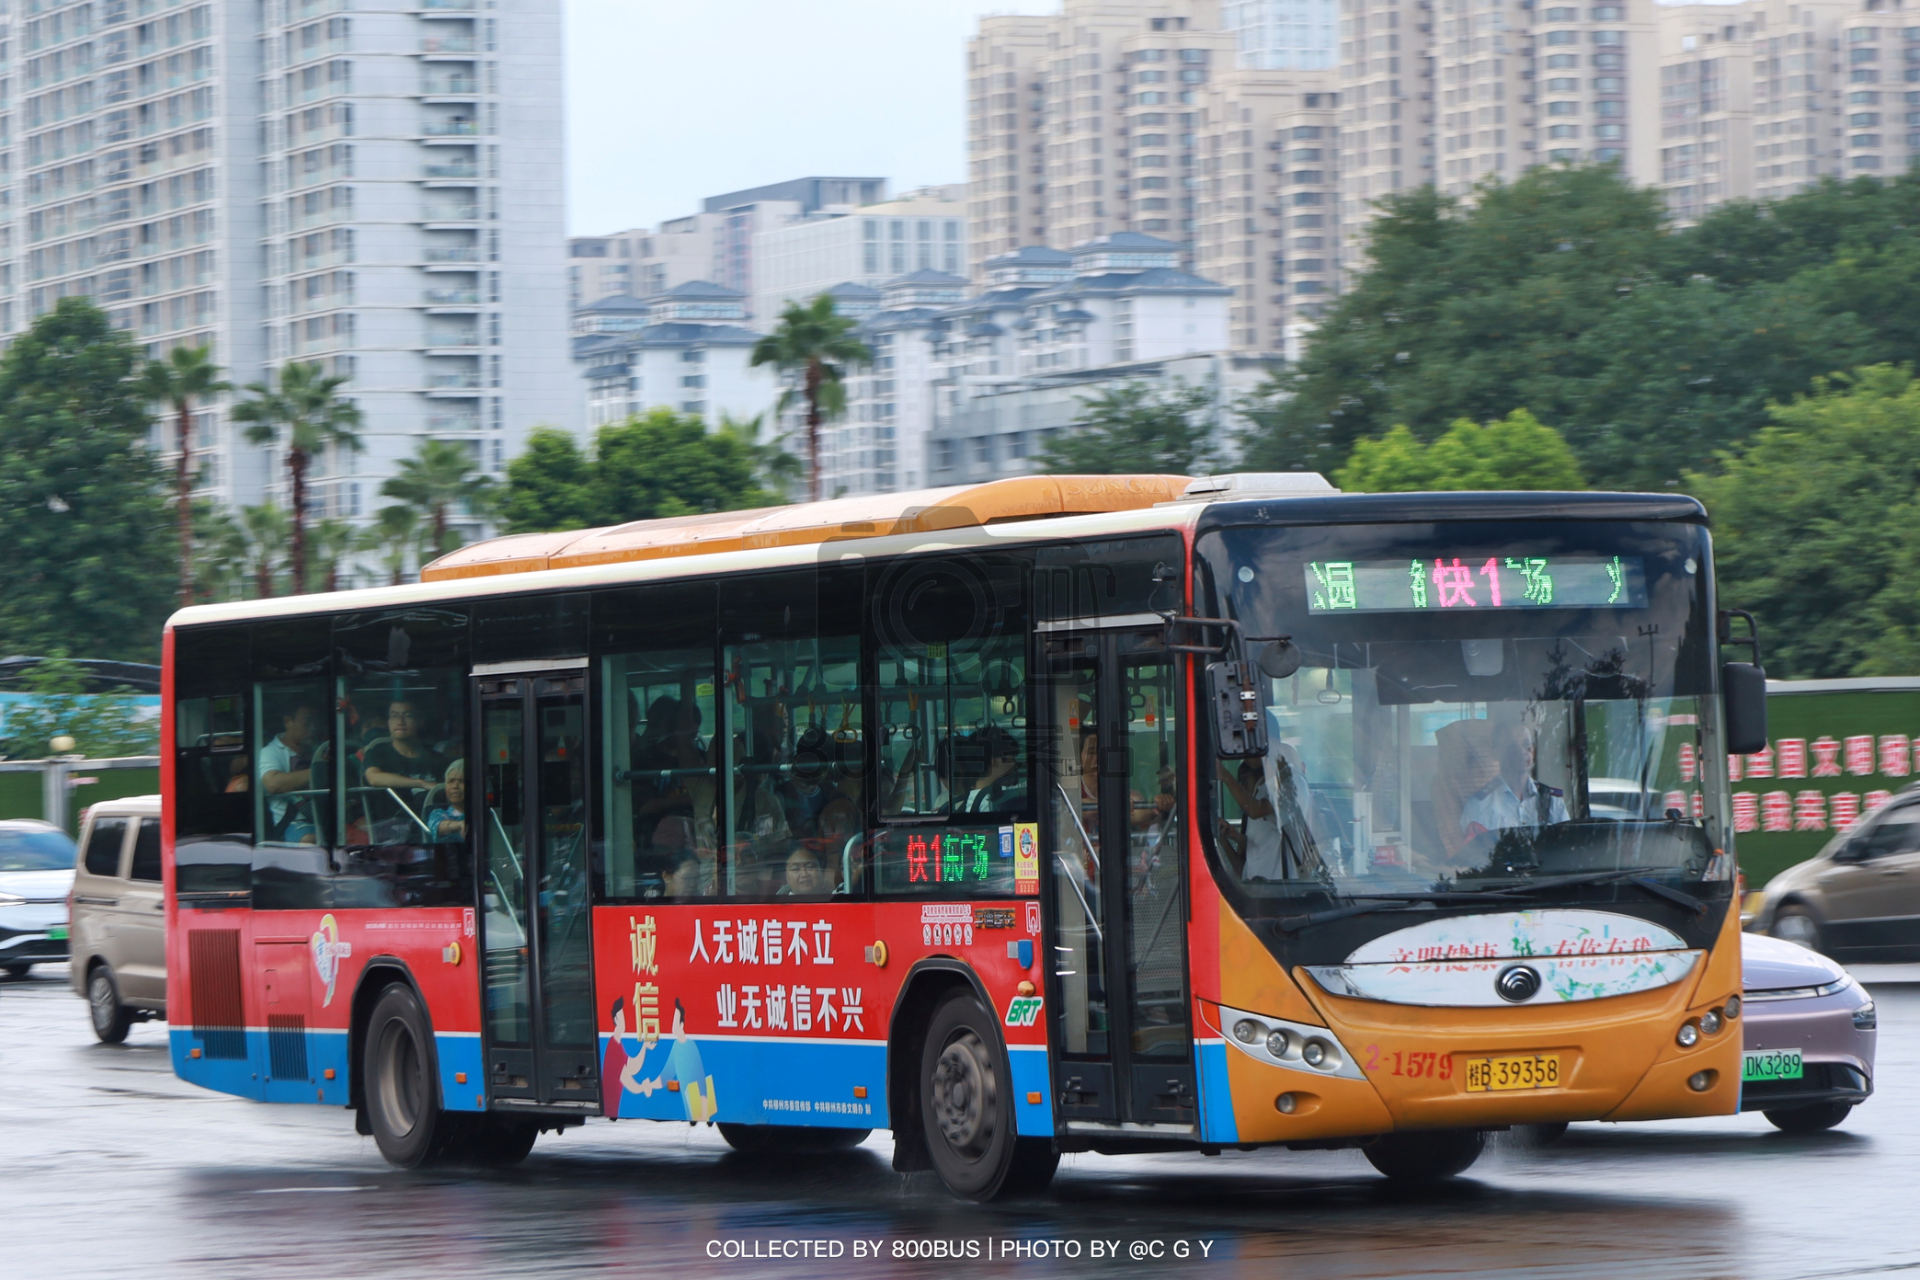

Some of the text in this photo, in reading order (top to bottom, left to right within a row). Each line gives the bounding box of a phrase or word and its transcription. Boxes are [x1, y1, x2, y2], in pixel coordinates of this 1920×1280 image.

[689, 919, 834, 965] 人无诚信不立
[1386, 937, 1652, 975] 文明健康 有你有我
[629, 915, 660, 1043] 诚信
[716, 984, 865, 1033] 业无诚信不兴
[1006, 998, 1043, 1024] BRT
[1365, 1044, 1454, 1081] 2-1579
[1746, 1054, 1800, 1077] DK3289
